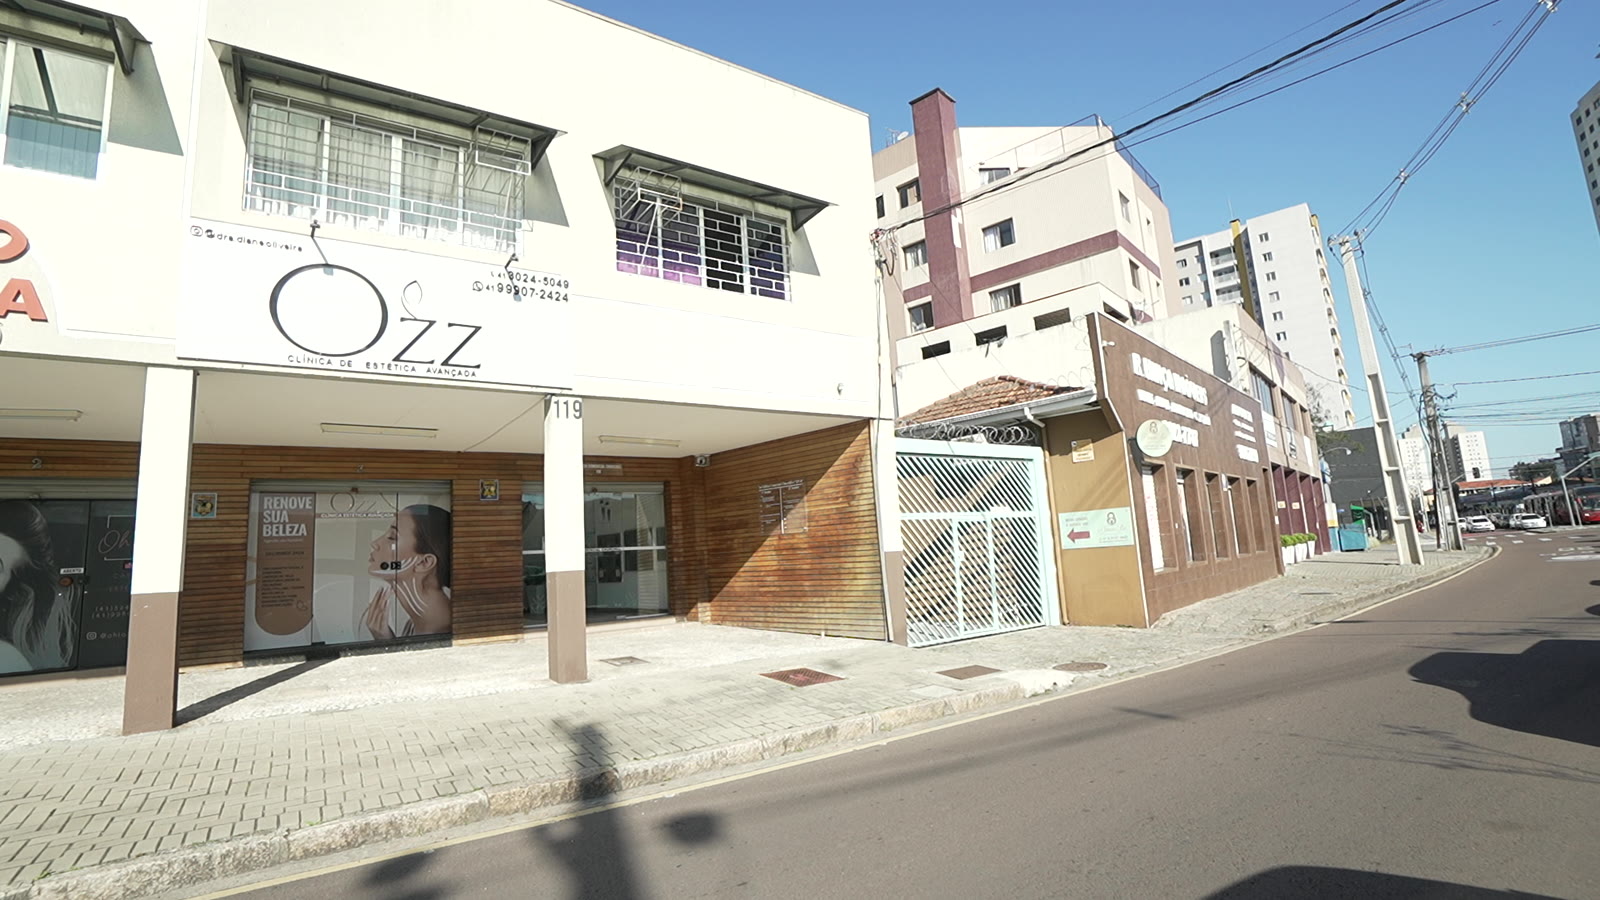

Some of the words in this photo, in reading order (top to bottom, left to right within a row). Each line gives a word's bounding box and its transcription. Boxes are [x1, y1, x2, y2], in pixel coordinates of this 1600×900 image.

[426, 367, 476, 378] AVANÇADA
[553, 399, 582, 419] 119
[264, 496, 312, 509] RENOVE
[263, 510, 289, 523] SUA
[263, 524, 307, 537] BELEZA
